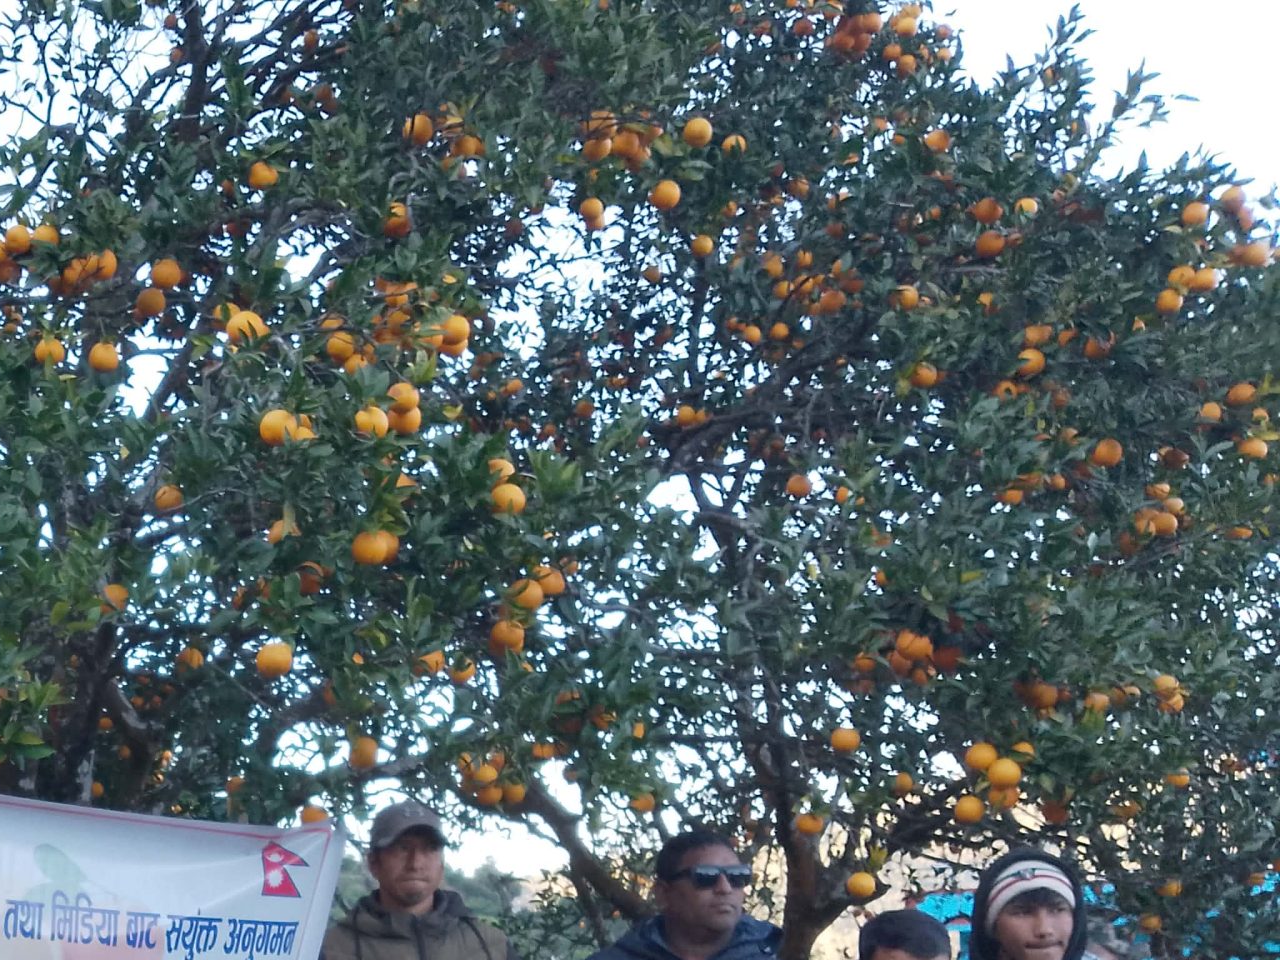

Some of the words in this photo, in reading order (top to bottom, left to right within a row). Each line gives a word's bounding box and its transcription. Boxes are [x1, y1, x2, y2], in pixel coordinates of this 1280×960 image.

[4, 899, 45, 939] तथा
[51, 890, 120, 947] मिडिया
[127, 911, 161, 949] बाट
